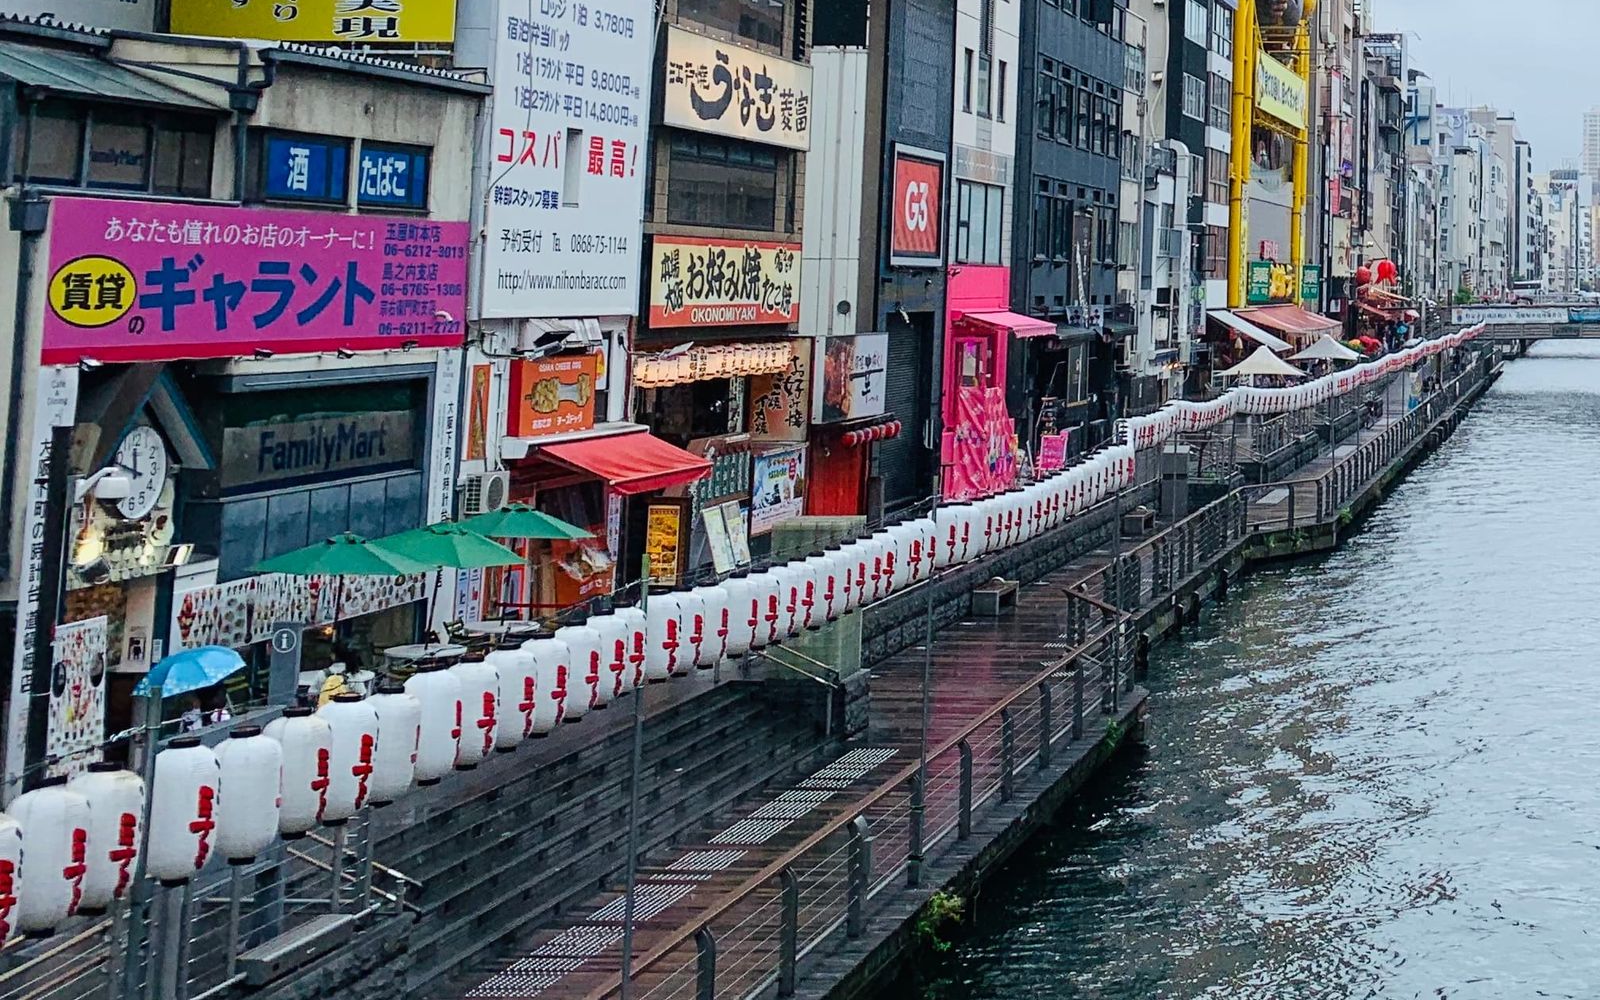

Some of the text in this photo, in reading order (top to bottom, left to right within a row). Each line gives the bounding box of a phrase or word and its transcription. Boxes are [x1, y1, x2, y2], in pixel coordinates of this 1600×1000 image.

[572, 3, 588, 27] 1泊
[594, 10, 634, 39] 3,780円
[565, 62, 584, 86] 平日
[690, 49, 778, 132] うなぎ
[563, 94, 583, 119] 平日
[498, 128, 637, 178] コスパ 最高!
[287, 146, 406, 198] 酒 たばこ
[494, 185, 560, 209] 幹部スタッフ募集
[904, 179, 929, 232] G3
[104, 216, 376, 252] あなたも憧れのお店のオーナーに!
[500, 227, 543, 254] 予約受付
[570, 233, 628, 254] 0868-75-1144
[497, 267, 627, 295] http://www.nihonbaracc.com
[686, 247, 762, 301] お好み焼
[61, 254, 376, 334] 賃貸 の ギャラント
[690, 307, 756, 322] OKONOMIYAKI
[257, 420, 389, 472] FamilyMart
